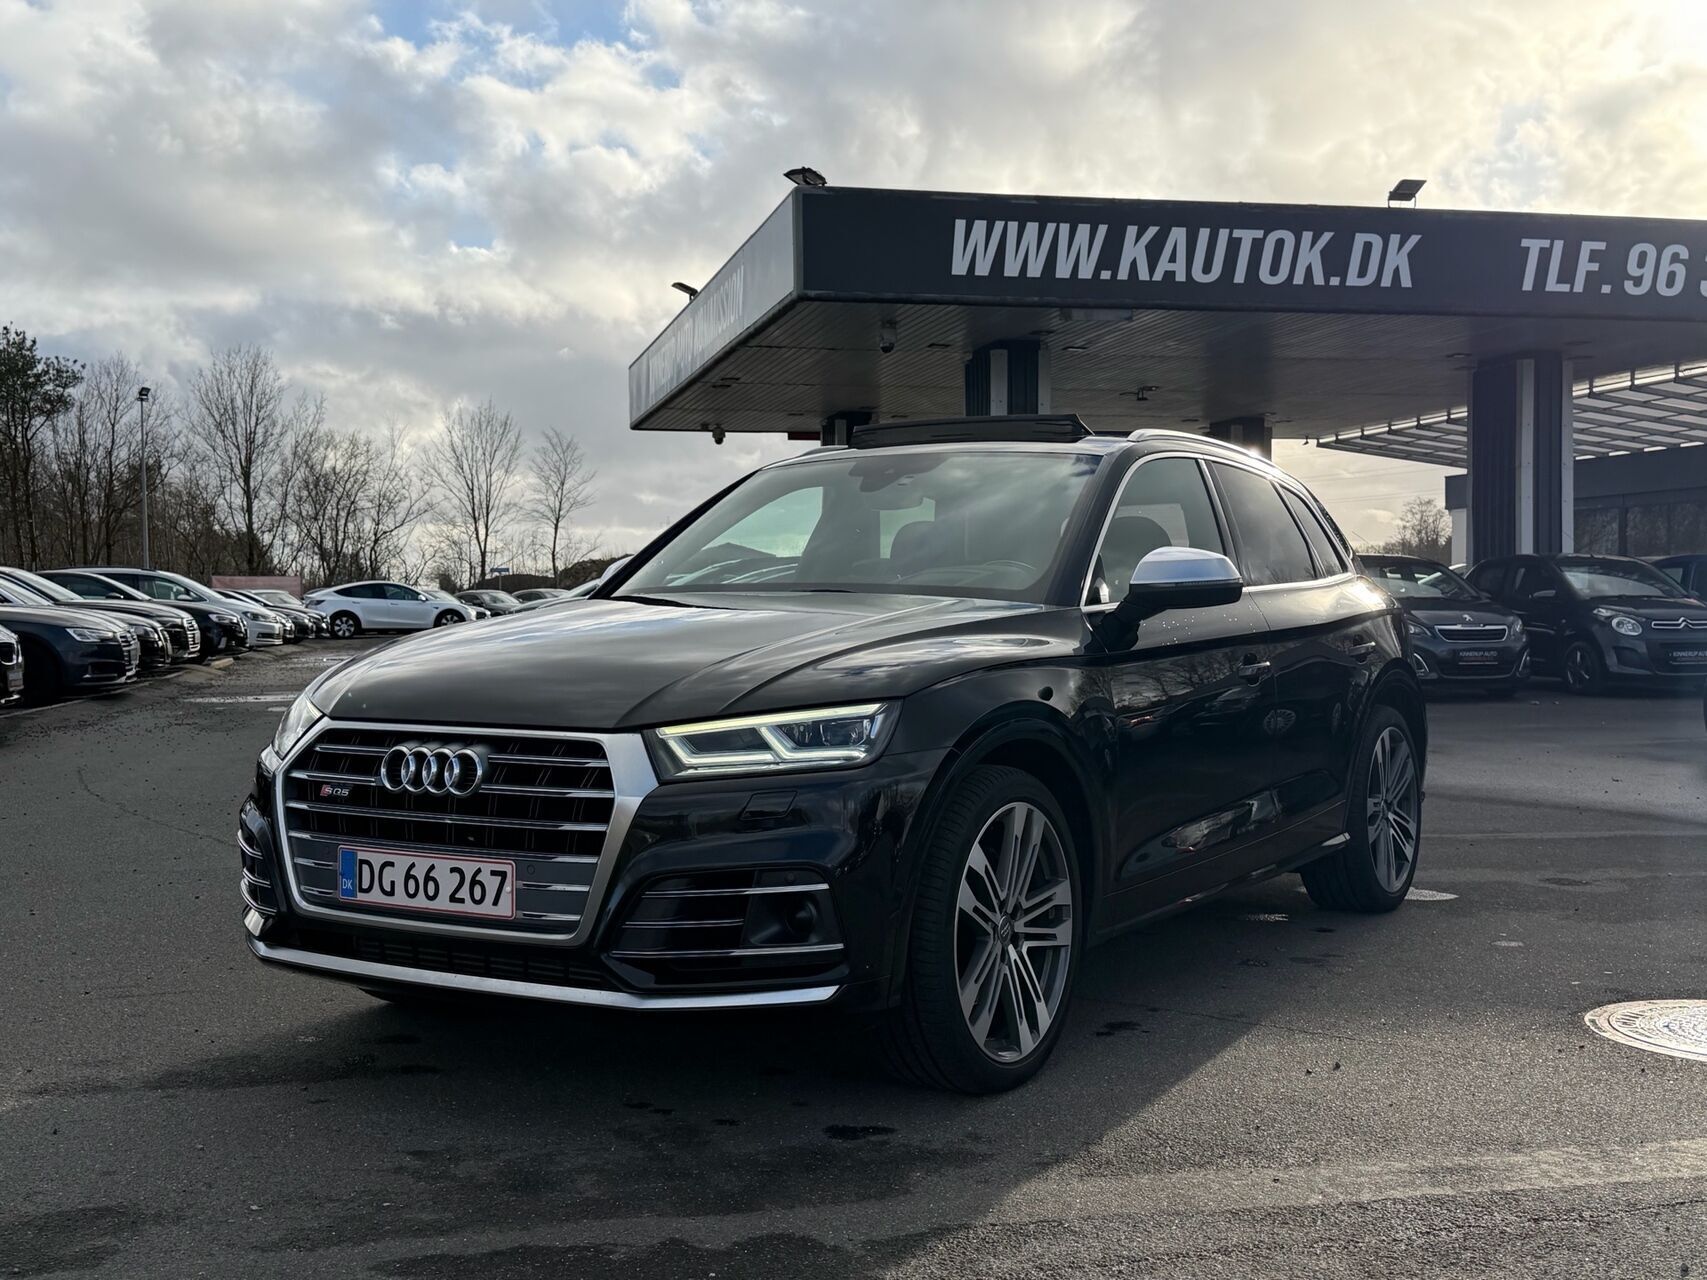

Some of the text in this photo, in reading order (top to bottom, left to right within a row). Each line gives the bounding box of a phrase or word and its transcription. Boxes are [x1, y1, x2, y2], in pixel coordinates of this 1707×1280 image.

[951, 218, 1422, 288] WWW.KAUTOK.DK
[1520, 238, 1612, 294] TLF.
[1623, 242, 1689, 297] 96
[319, 784, 350, 797] SQ5
[342, 878, 353, 890] DK
[358, 858, 508, 907] DG 66 267
